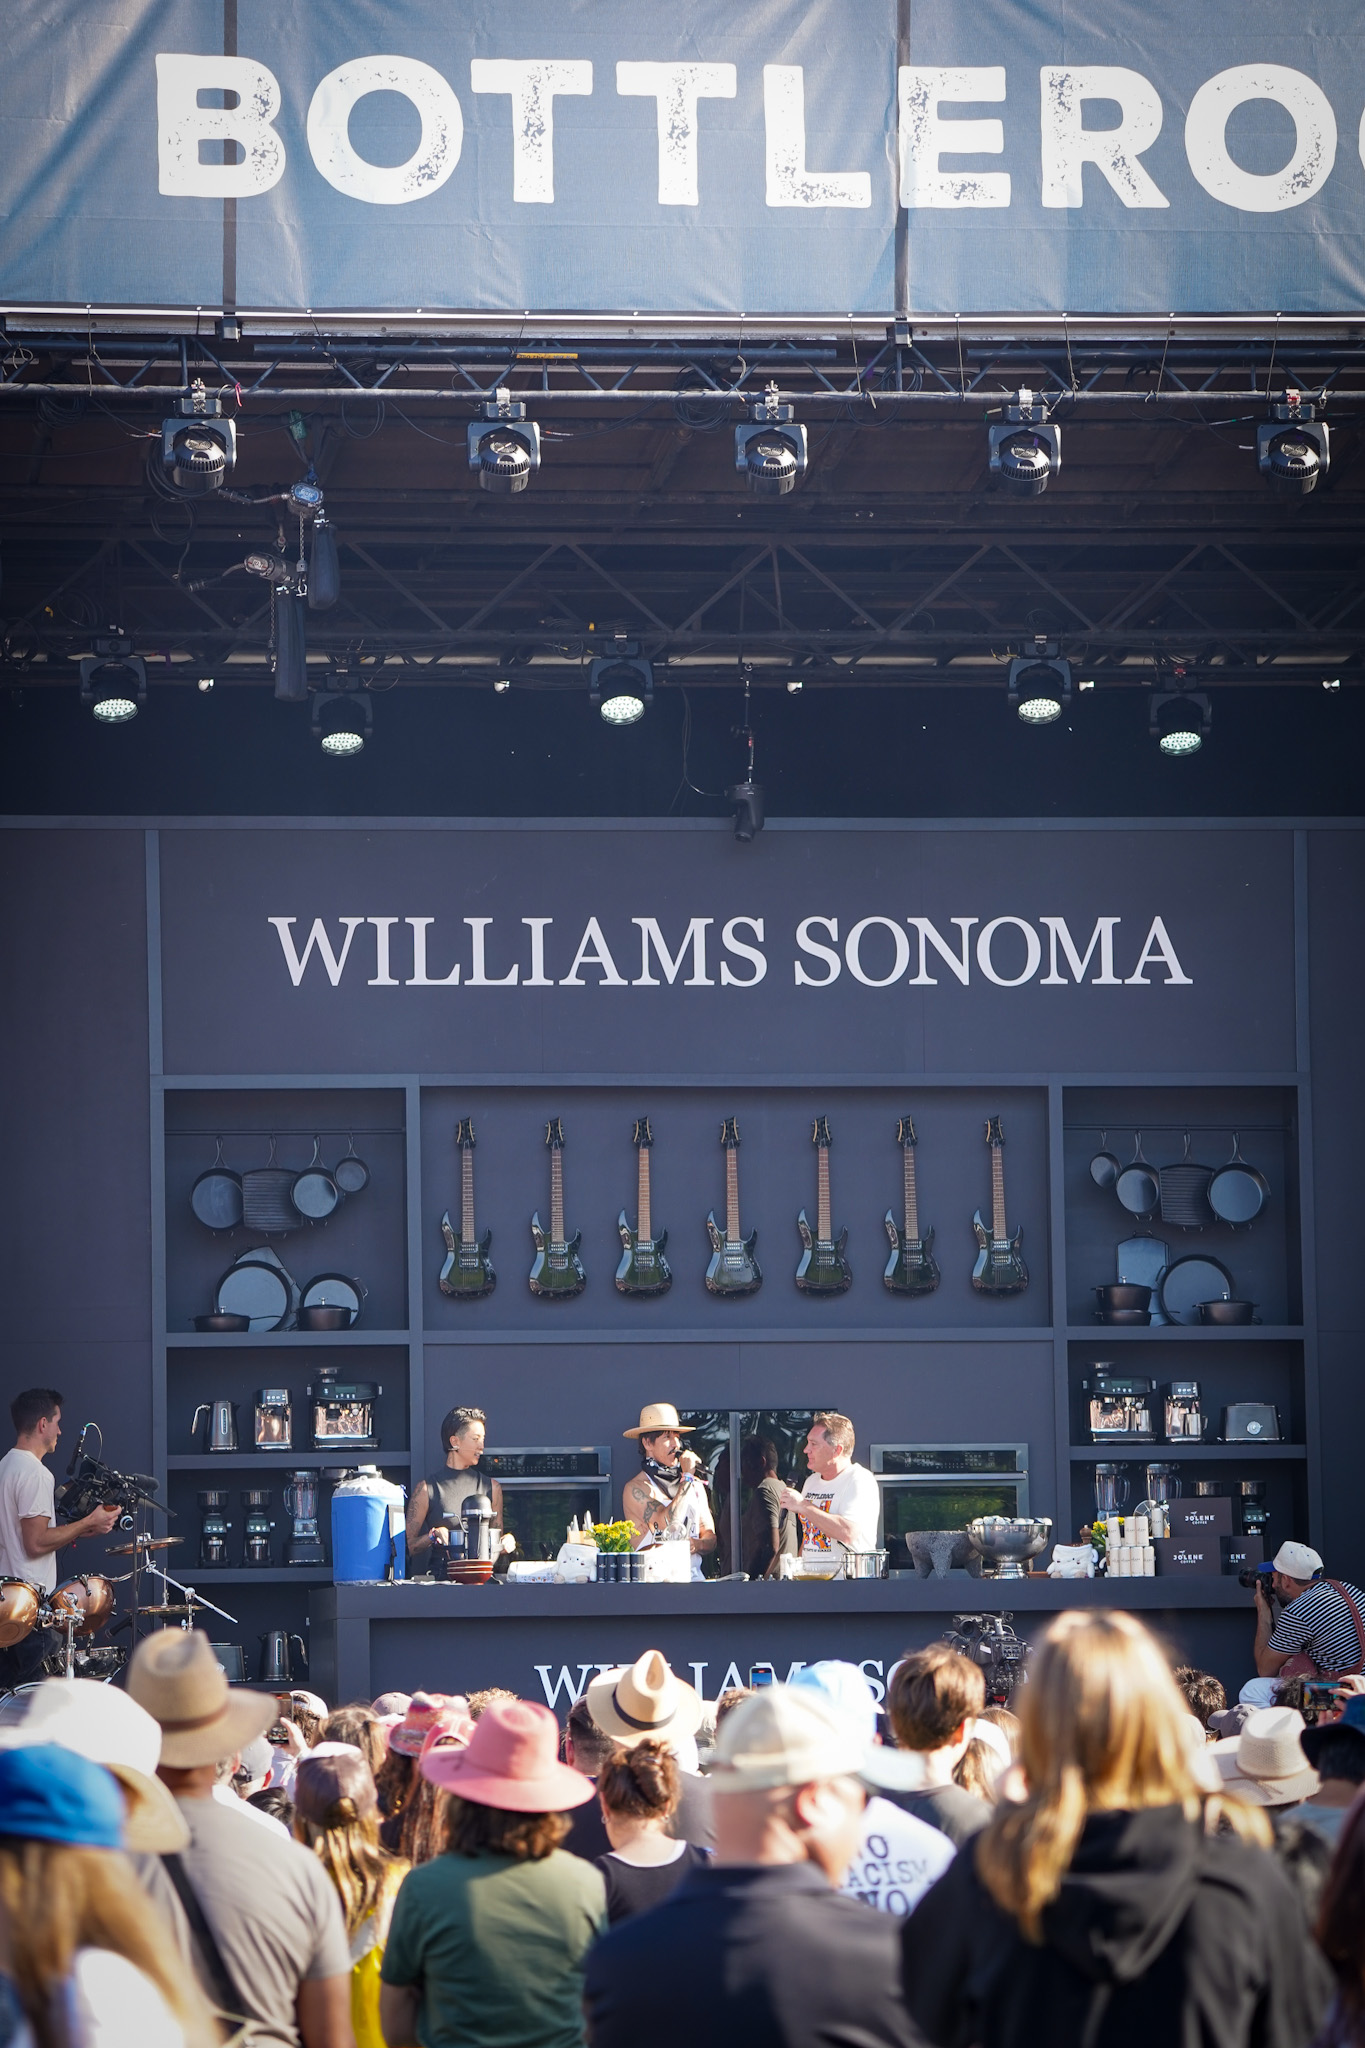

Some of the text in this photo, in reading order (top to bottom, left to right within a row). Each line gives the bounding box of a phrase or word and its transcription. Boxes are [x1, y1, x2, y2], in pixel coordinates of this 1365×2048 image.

[156, 54, 1365, 213] BOTTLERO
[267, 916, 1194, 987] WILLIAMS SONOMA
